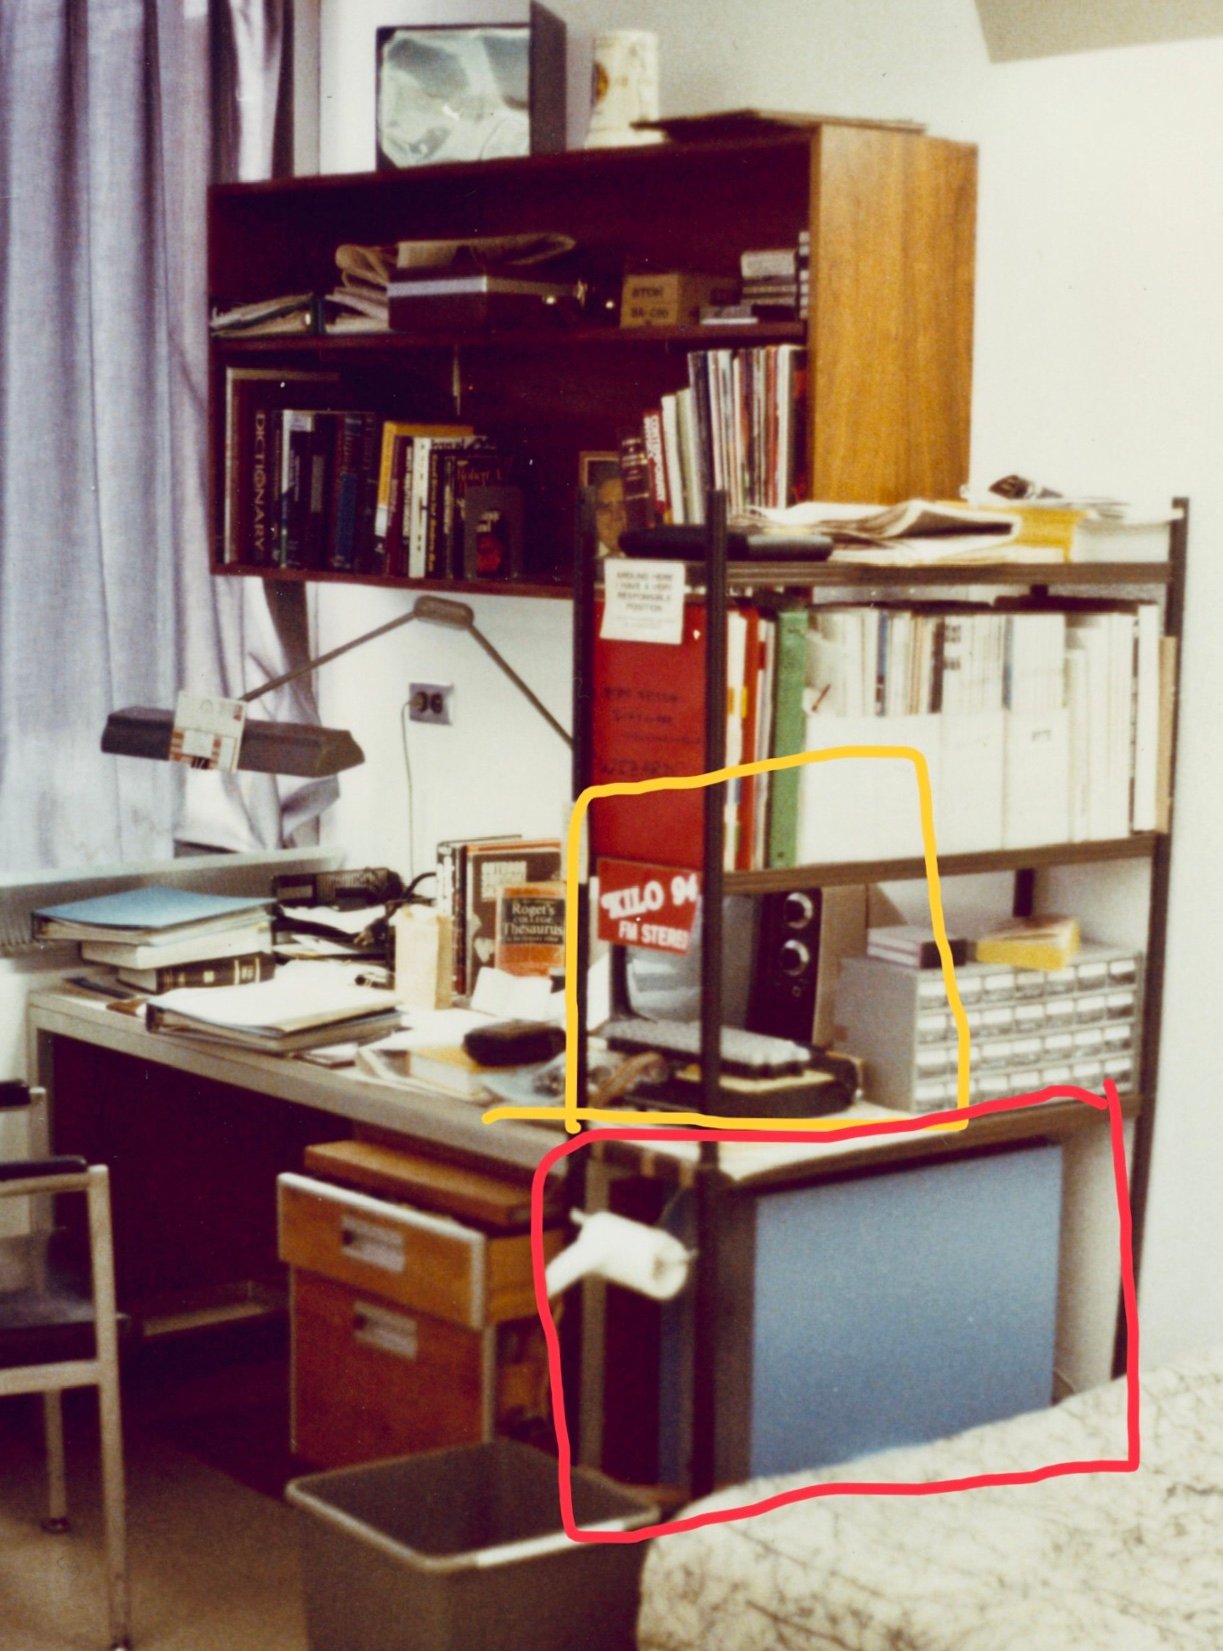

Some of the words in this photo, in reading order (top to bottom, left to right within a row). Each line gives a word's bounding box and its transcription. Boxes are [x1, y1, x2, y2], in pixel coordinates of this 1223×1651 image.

[254, 412, 266, 550] DICTIONARY
[617, 592, 671, 602] RESPONSIBLE
[601, 880, 664, 919] KILO
[512, 902, 556, 917] Roget's
[504, 923, 564, 935] Thesaurus
[619, 920, 637, 941] FM
